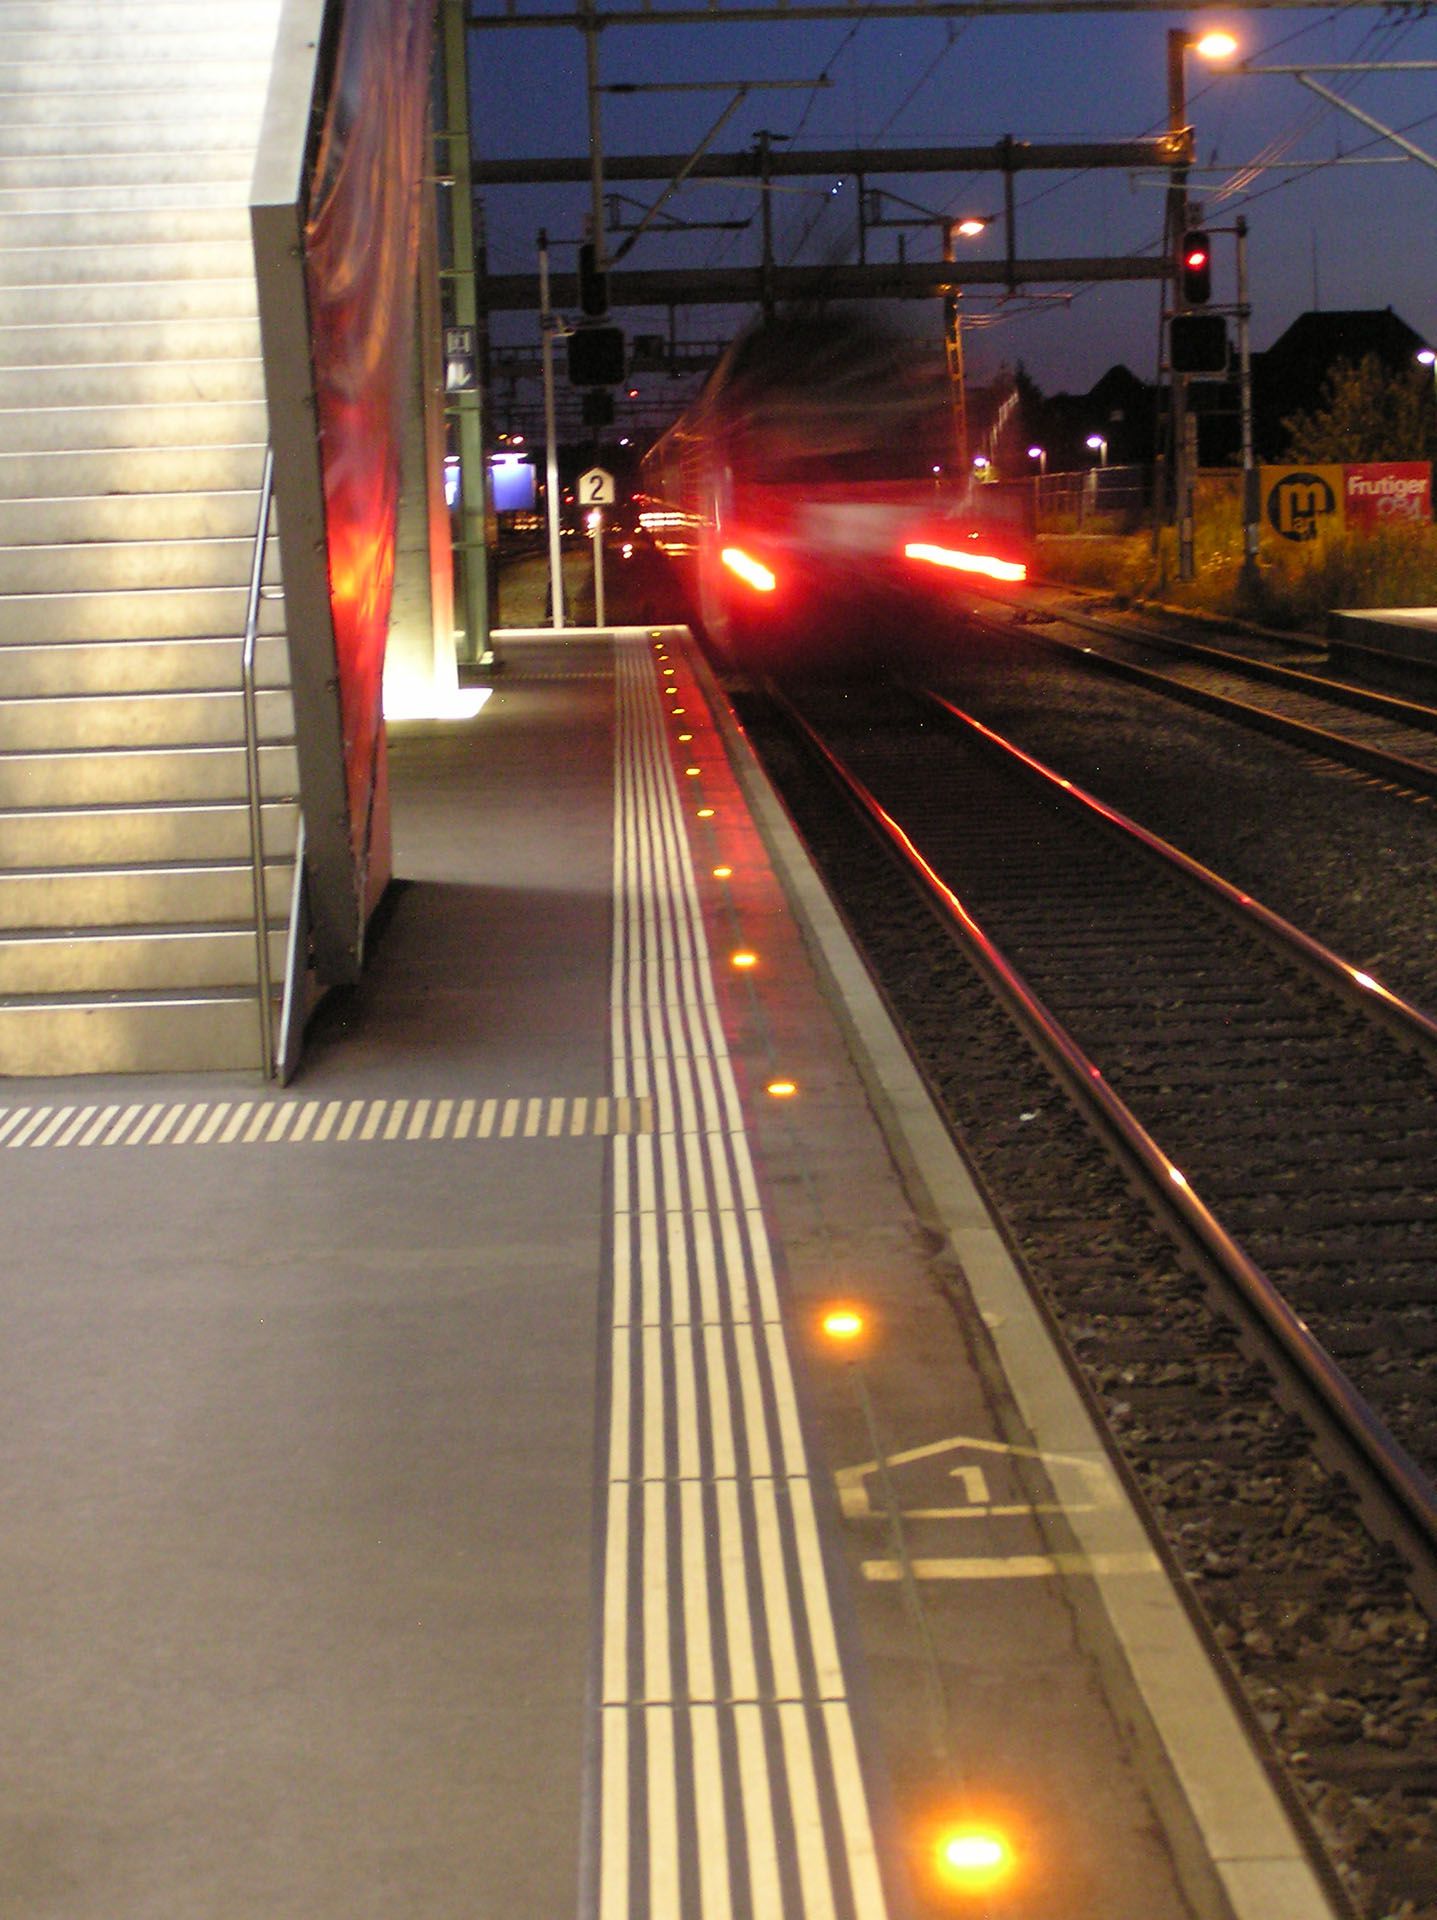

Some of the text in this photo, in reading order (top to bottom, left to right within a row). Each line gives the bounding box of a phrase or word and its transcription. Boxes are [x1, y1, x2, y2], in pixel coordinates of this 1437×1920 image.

[589, 475, 604, 501] 2
[1348, 474, 1427, 498] Frutiger
[949, 1465, 990, 1503] 1
